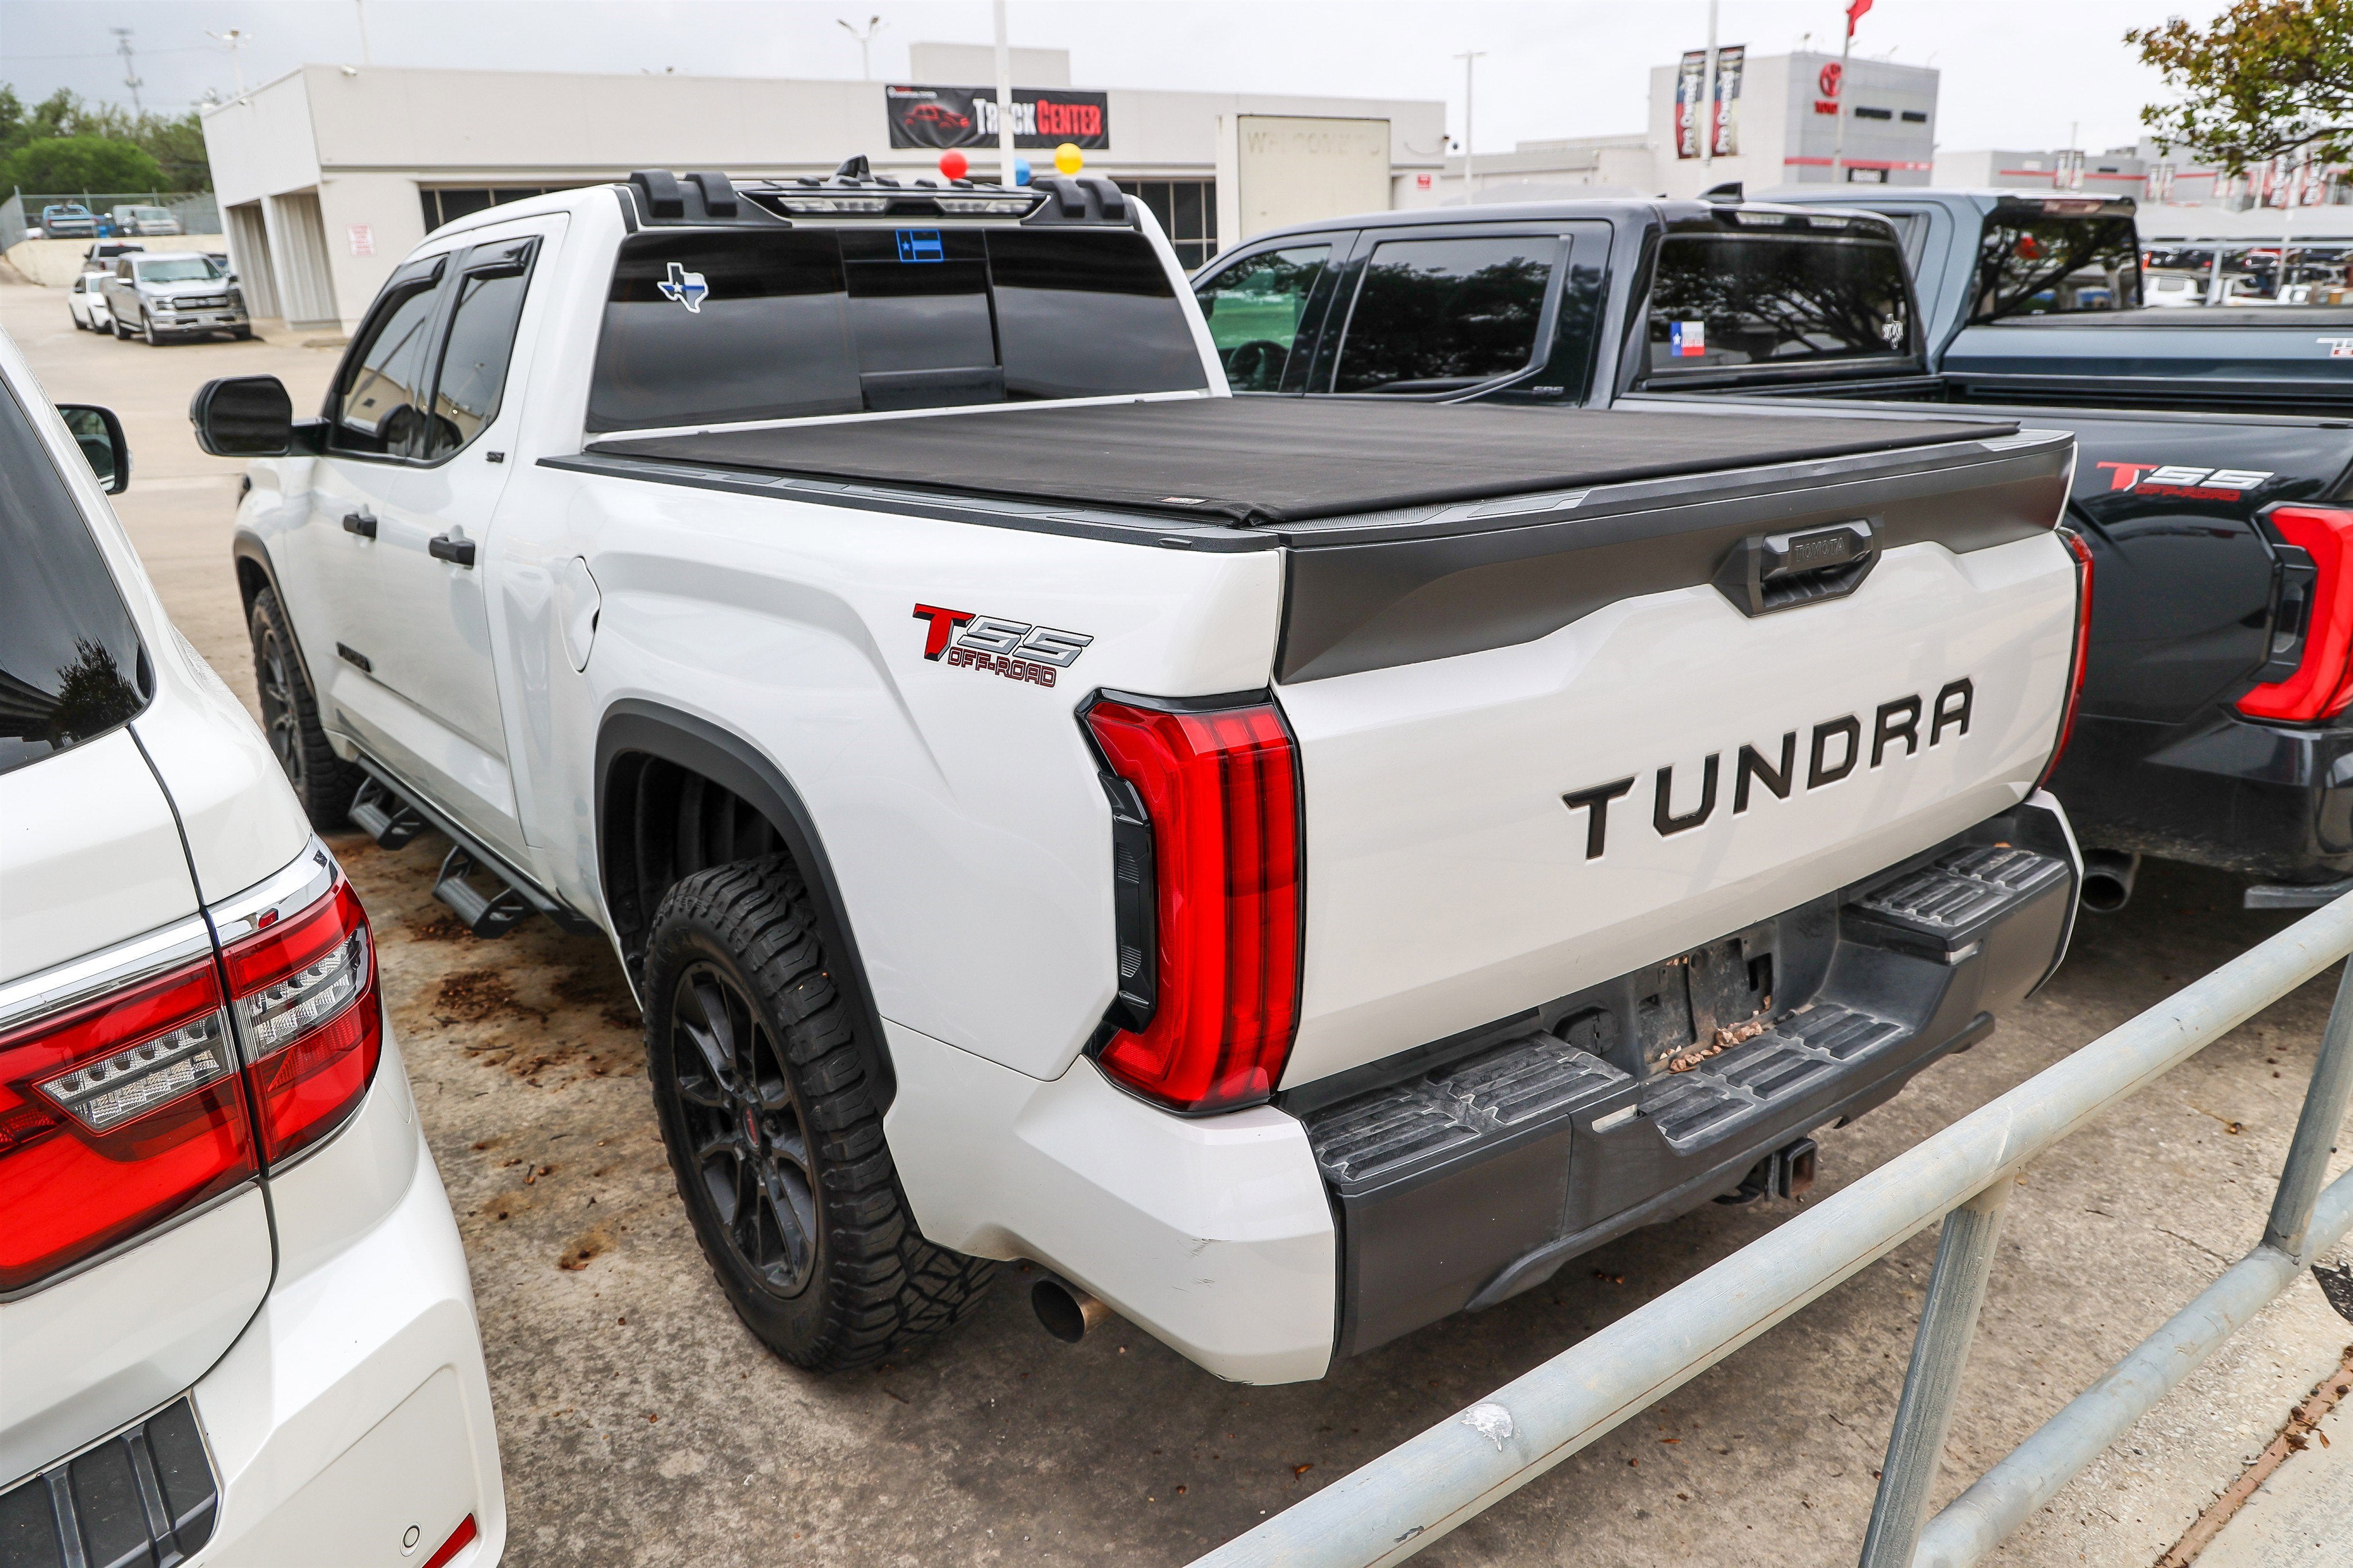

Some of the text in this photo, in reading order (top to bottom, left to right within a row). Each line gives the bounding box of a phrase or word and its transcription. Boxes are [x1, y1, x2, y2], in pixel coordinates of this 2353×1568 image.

[972, 98, 1037, 136] TRCK
[2096, 461, 2275, 492] TSS
[1795, 537, 1846, 562] TOYOTA
[912, 603, 1094, 668] TSS
[947, 646, 1057, 688] OFF-ROAD
[1561, 676, 1974, 861] TUNDRA
